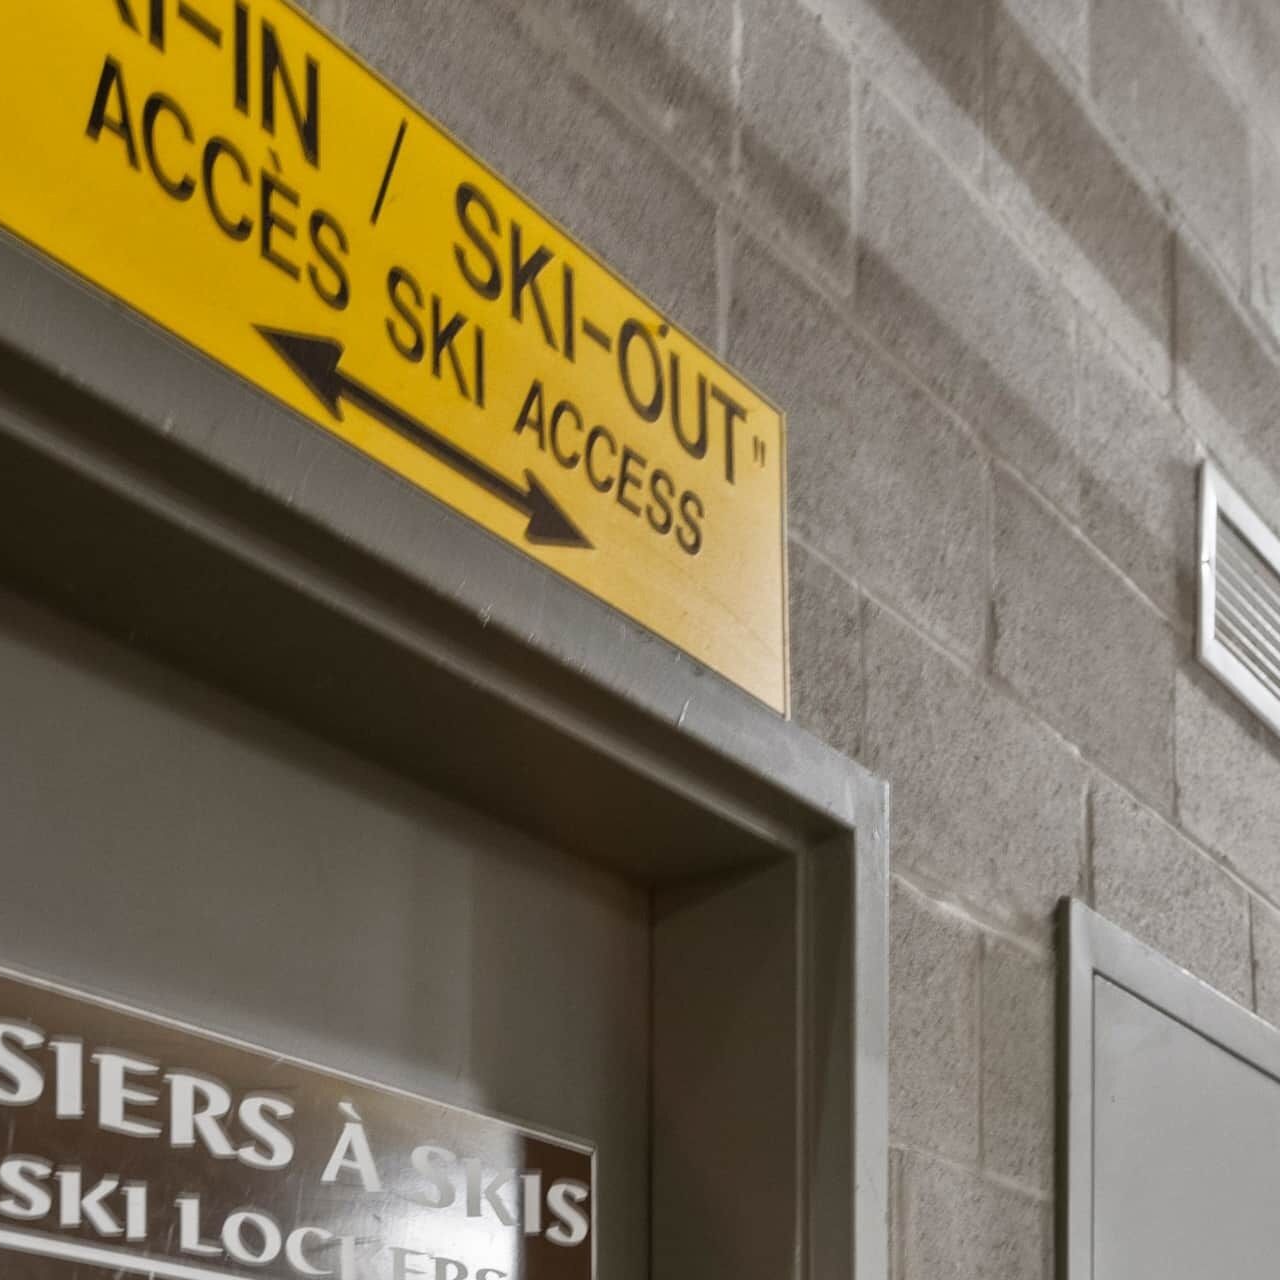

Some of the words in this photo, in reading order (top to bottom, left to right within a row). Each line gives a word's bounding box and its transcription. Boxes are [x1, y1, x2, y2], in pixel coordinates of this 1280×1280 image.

[115, 0, 320, 170] -IN
[85, 54, 350, 312] ACCÈS
[385, 265, 486, 410] SKI
[513, 380, 704, 556] ACCESS
[321, 1101, 383, 1193] À
[410, 1144, 590, 1247] SKIS
